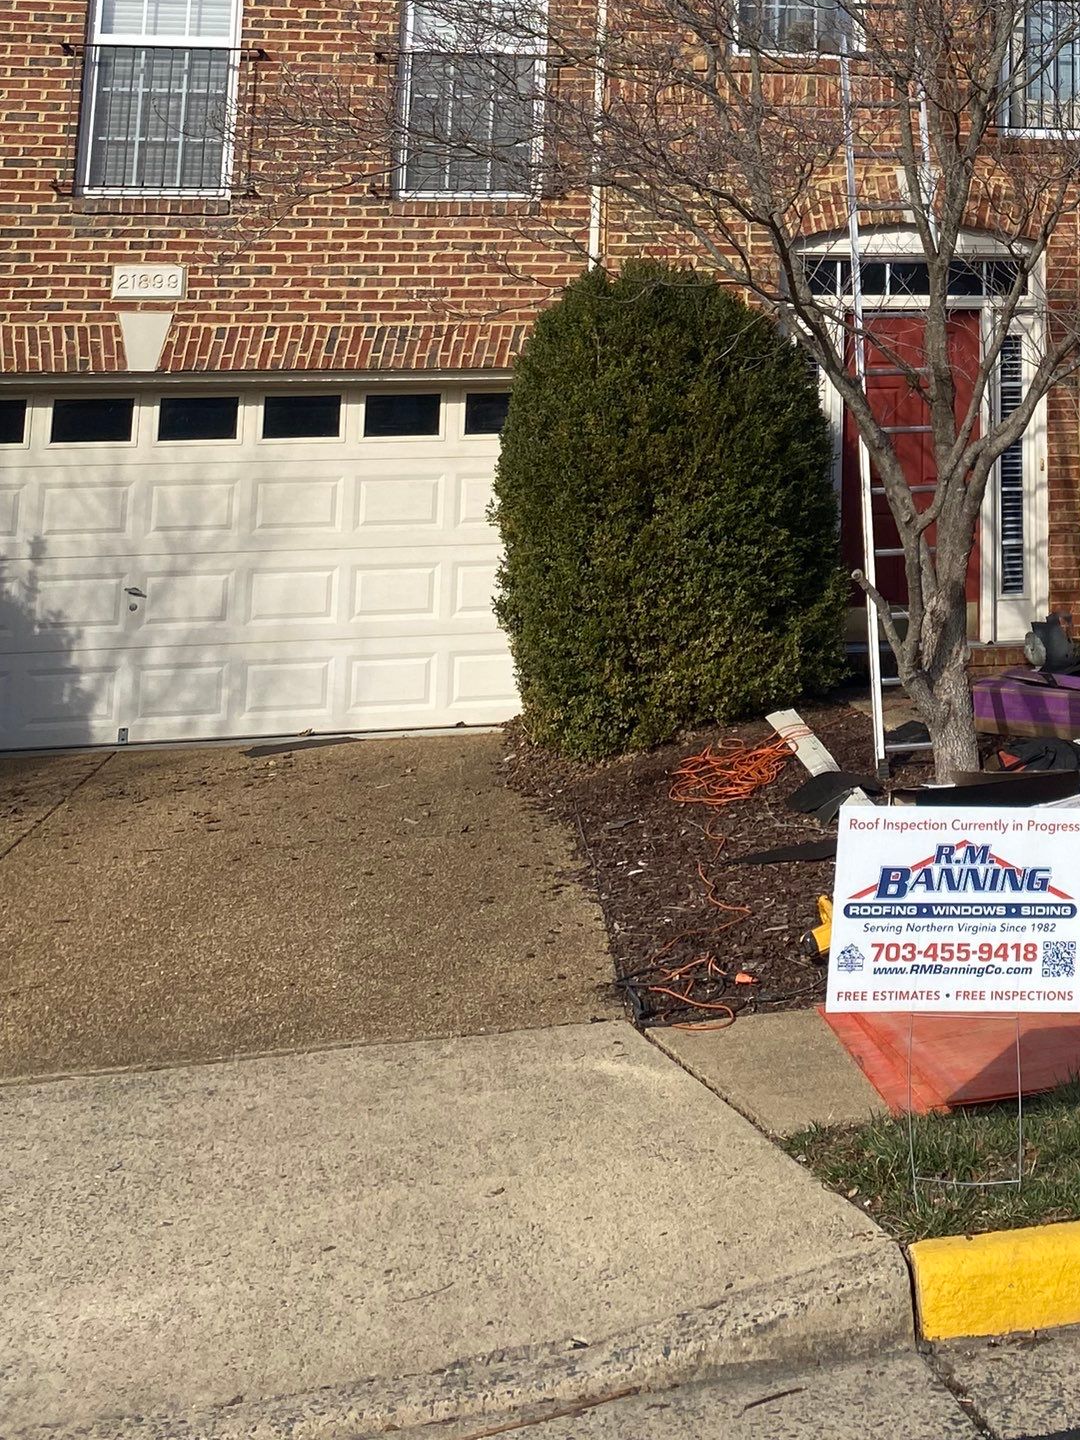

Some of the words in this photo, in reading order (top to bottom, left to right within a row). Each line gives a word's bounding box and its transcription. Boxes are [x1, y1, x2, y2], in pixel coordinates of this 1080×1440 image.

[117, 273, 179, 290] 21899
[849, 818, 880, 830] Roof
[883, 818, 947, 833] Inspection
[951, 819, 1009, 834] Currently
[1012, 820, 1023, 831] in
[1027, 820, 1080, 834] Progress
[934, 844, 995, 864] R.M.
[875, 866, 1051, 899] BANNING
[849, 905, 917, 915] ROOFING
[932, 905, 1007, 915] WINDOWS
[1020, 905, 1072, 915] SIDING
[863, 923, 902, 935] Serving
[906, 922, 953, 933] Northern
[957, 922, 997, 935] Virginia
[1000, 922, 1027, 933] Since
[1031, 922, 1056, 933] 1982
[871, 943, 1038, 962] 703-455-9418
[873, 964, 1032, 977] www.RMBanningCo.com
[837, 991, 868, 1001] FREE
[873, 990, 940, 1001] ESTIMATES
[955, 990, 986, 1001] FREE
[990, 990, 1074, 1001] INSPECTIONS
